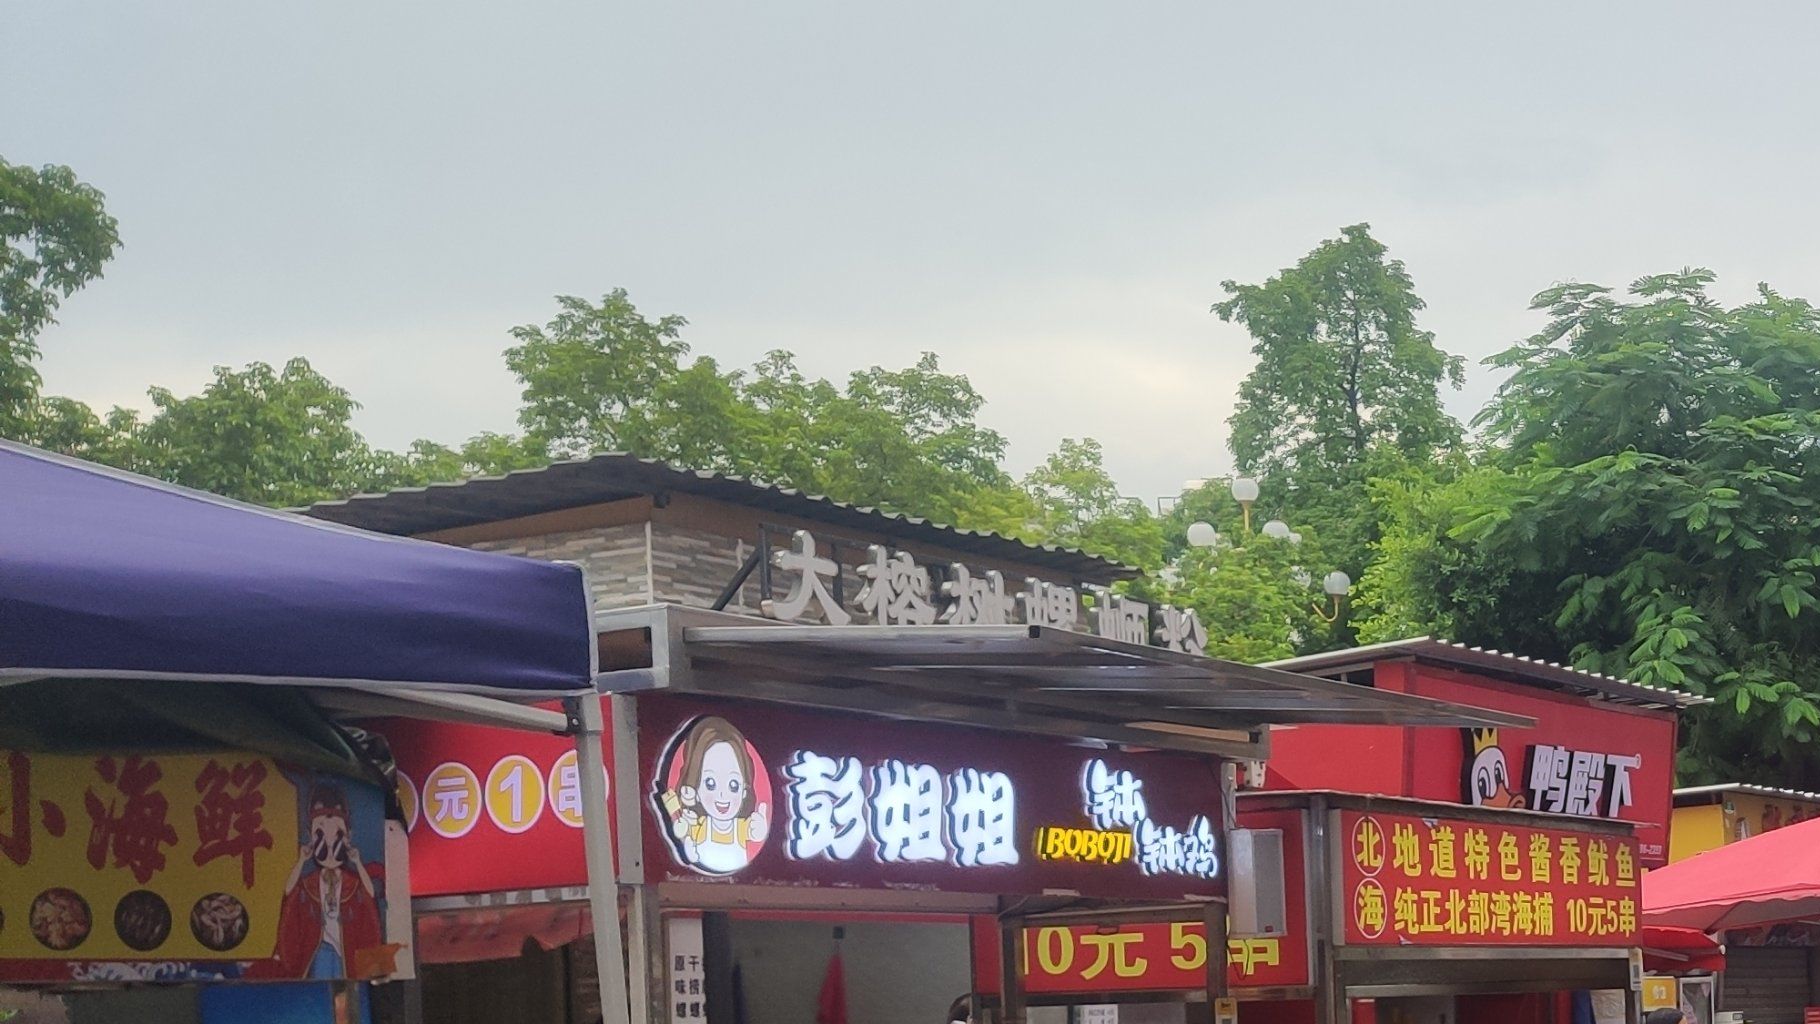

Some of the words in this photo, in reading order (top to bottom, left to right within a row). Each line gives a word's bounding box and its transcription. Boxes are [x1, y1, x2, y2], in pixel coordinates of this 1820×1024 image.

[785, 750, 1019, 868] 彭姐姐
[1529, 745, 1635, 818] 鸭殿下
[1393, 823, 1636, 888] 地道特色酱香鱿鱼
[1394, 887, 1553, 937] 纯正北部湾海捕
[1566, 896, 1636, 938] 10元5串
